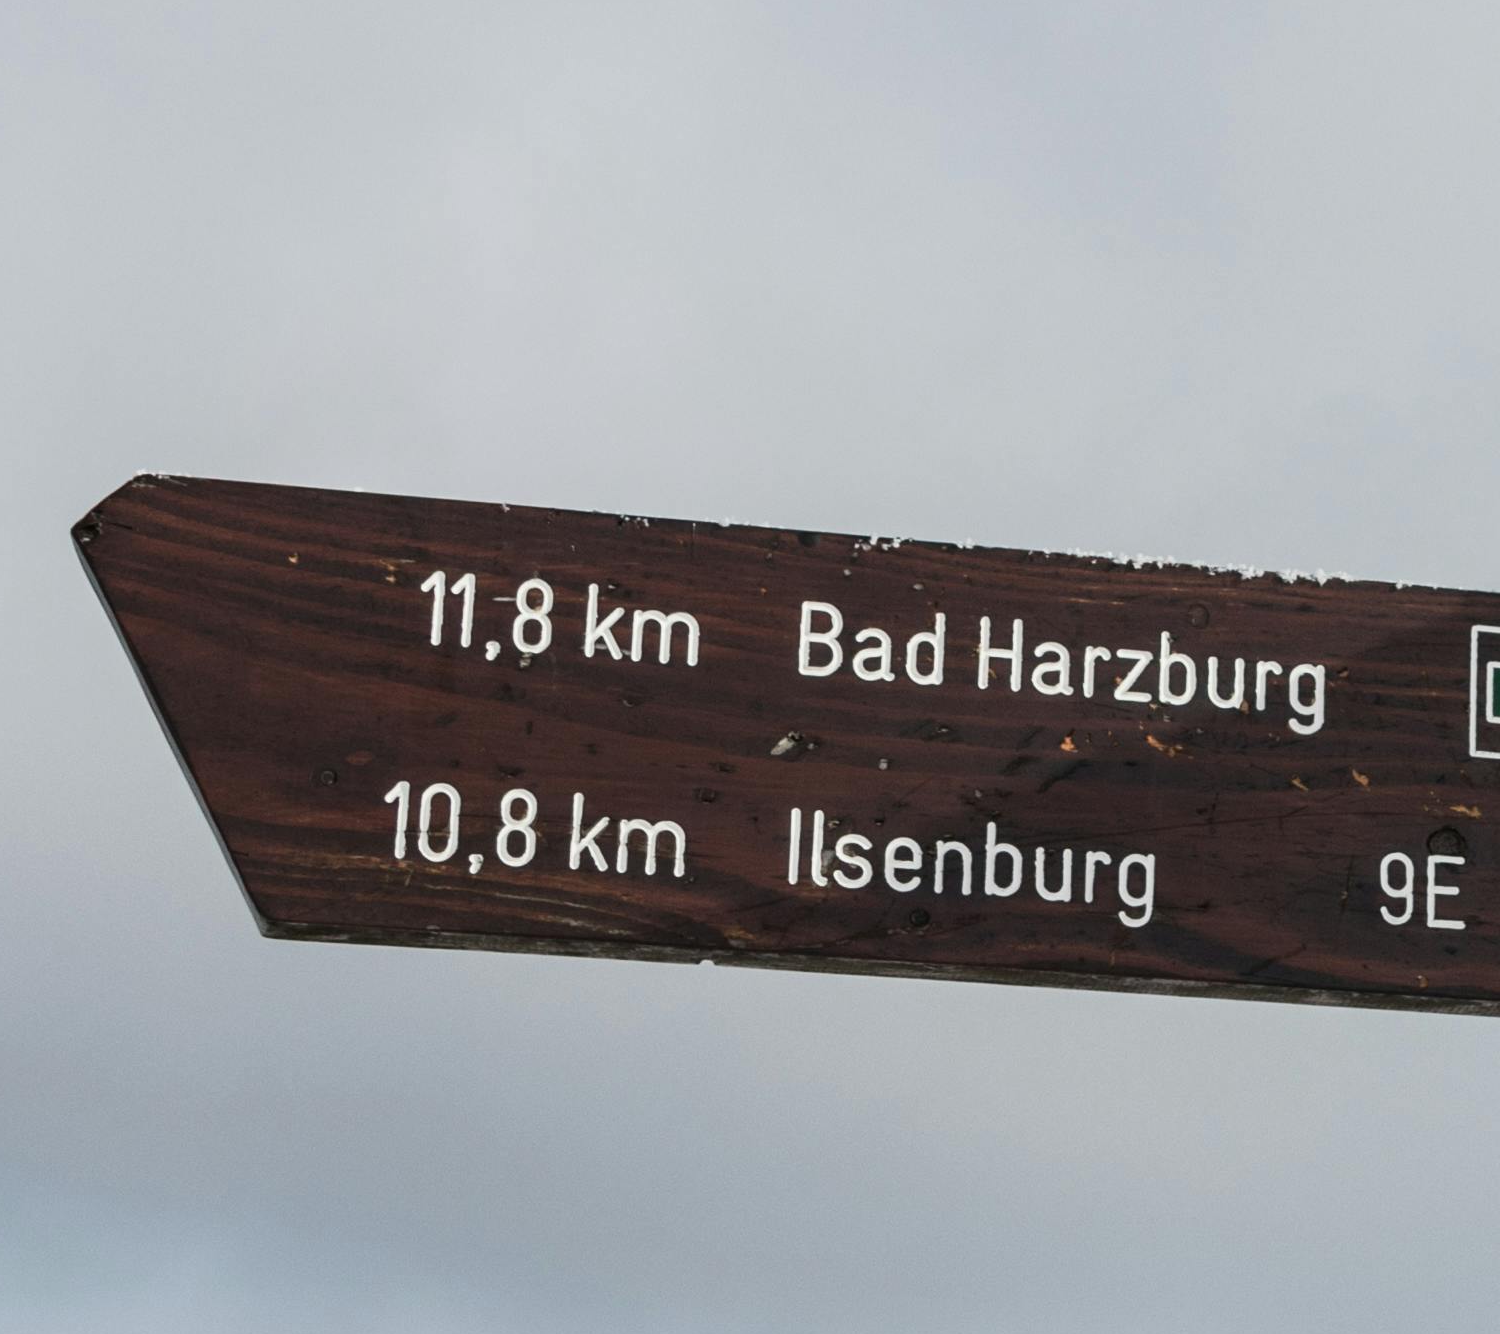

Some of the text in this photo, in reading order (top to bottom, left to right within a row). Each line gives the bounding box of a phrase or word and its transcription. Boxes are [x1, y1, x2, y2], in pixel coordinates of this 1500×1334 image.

[420, 570, 1326, 735] 11,8 km Bad Harzburg
[384, 781, 1156, 928] 10,8 km Ilsenburg
[1380, 852, 1466, 930] 9E
